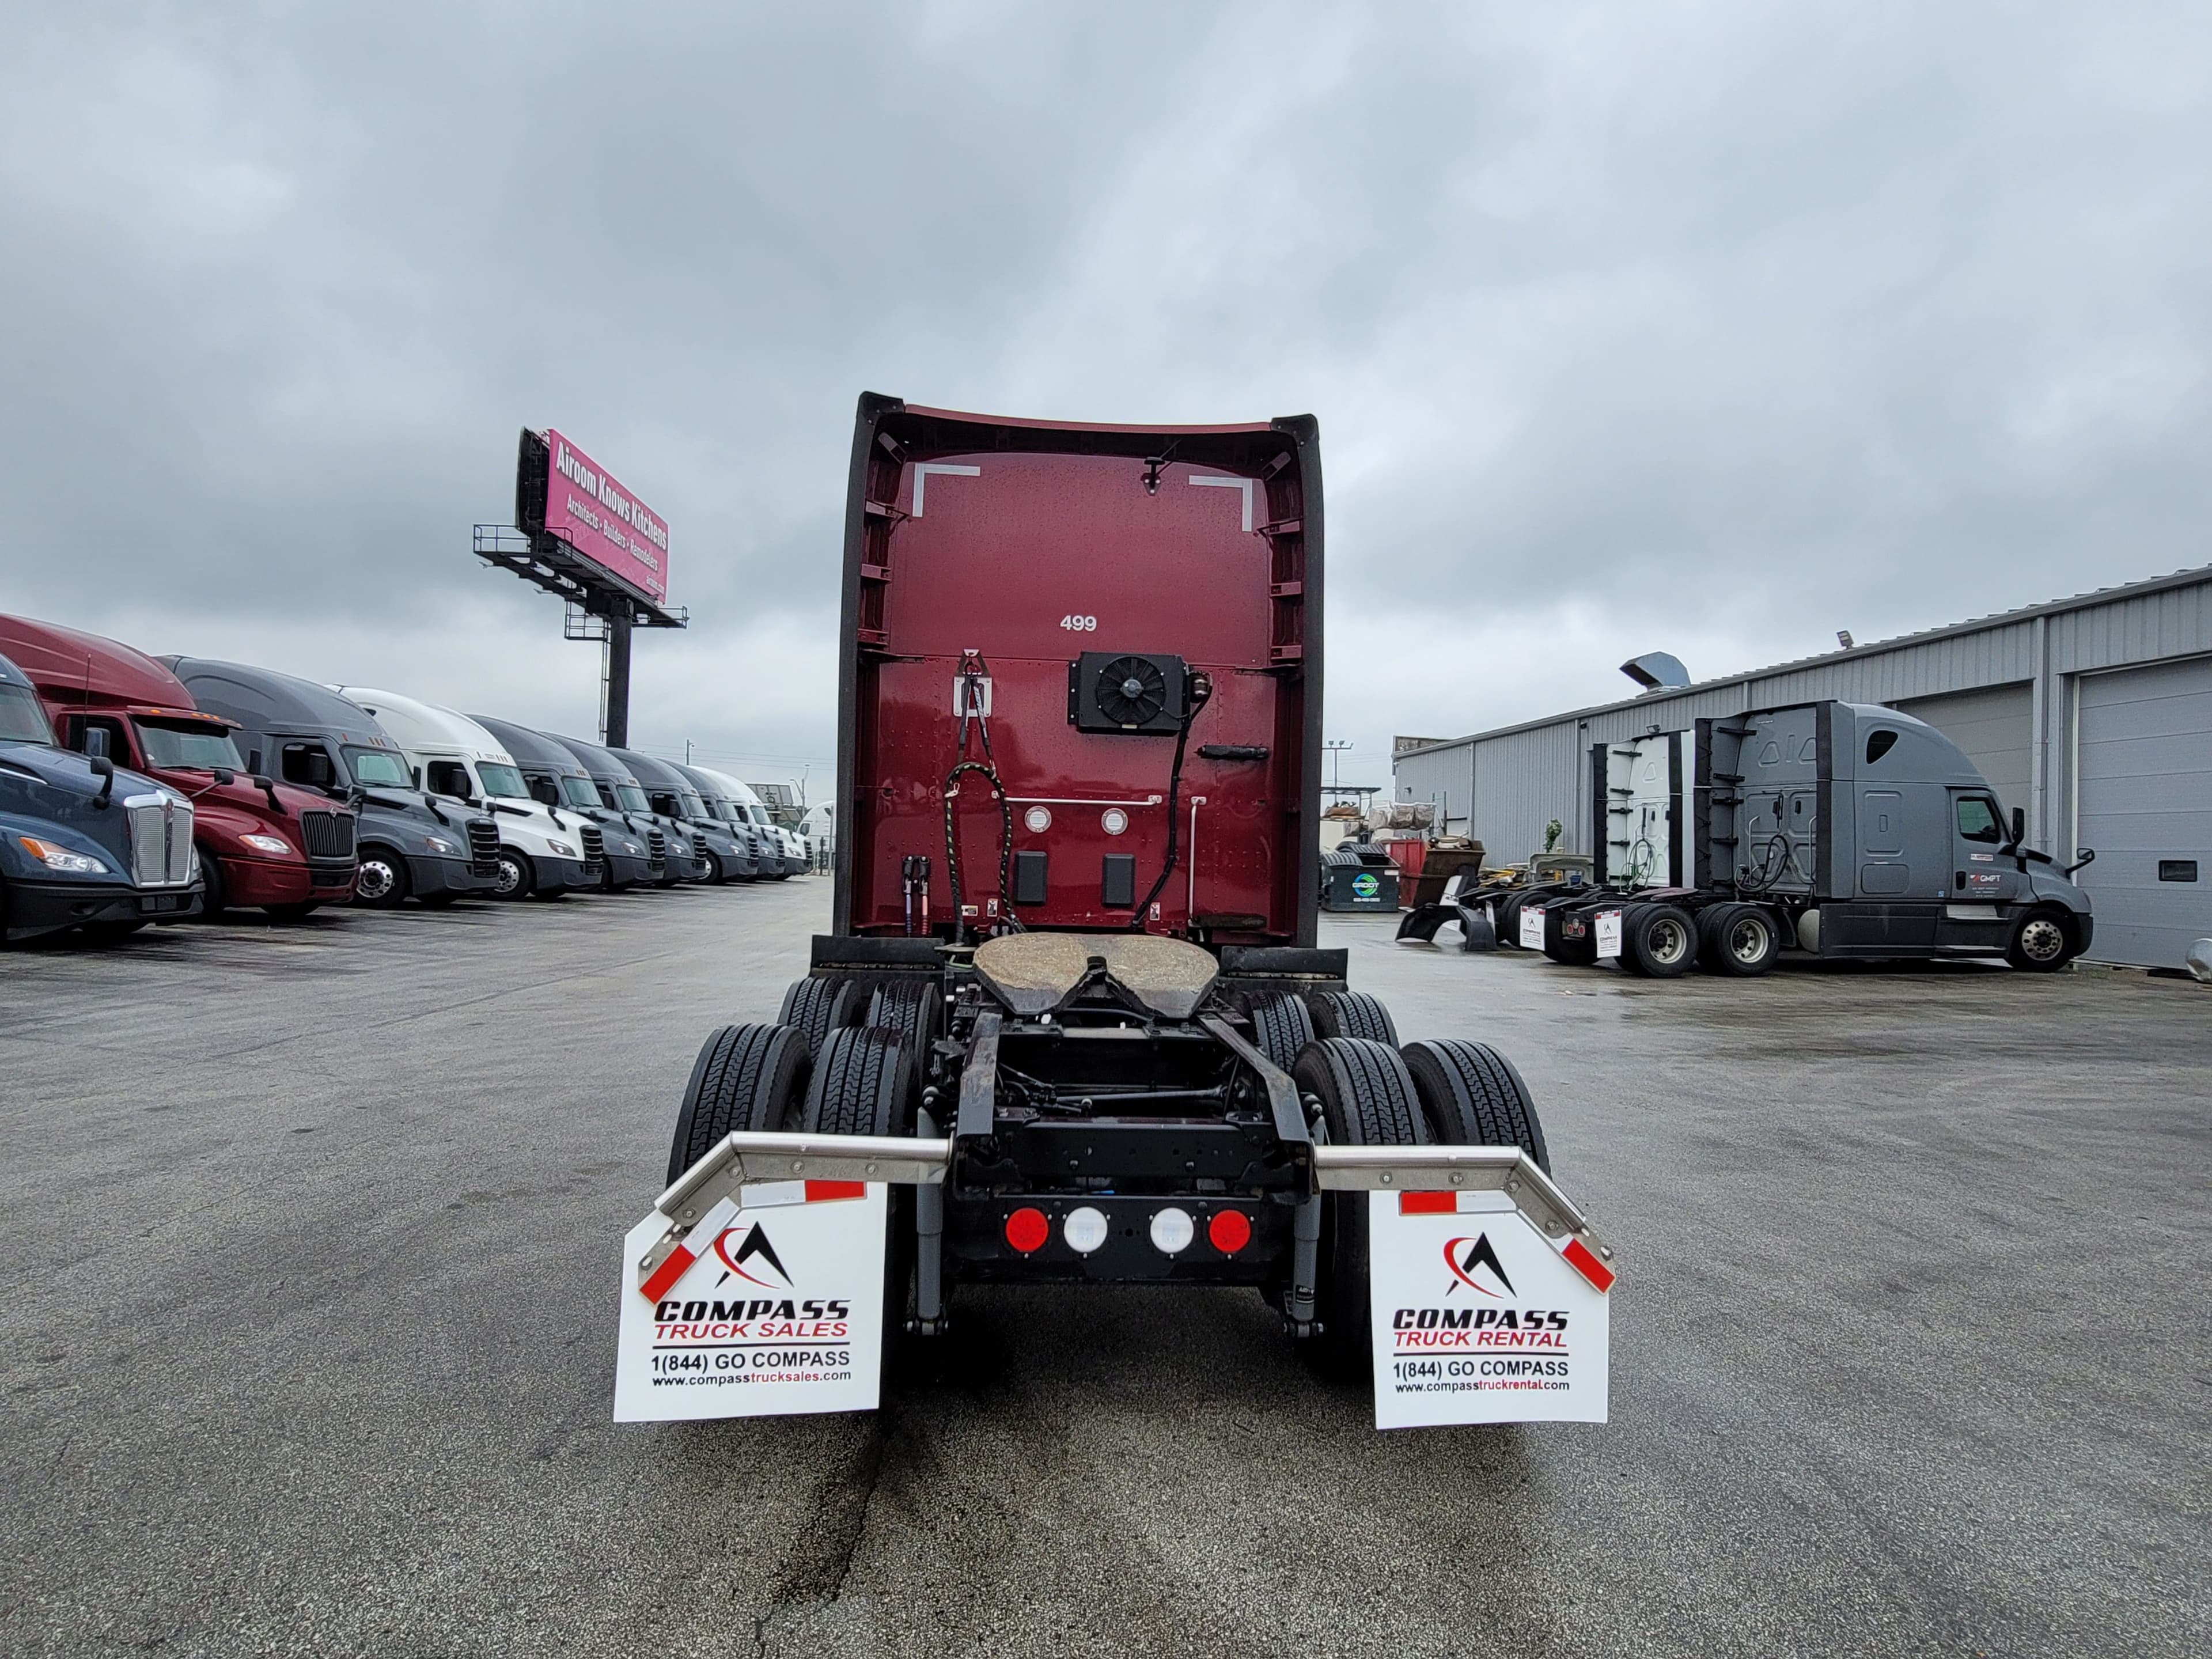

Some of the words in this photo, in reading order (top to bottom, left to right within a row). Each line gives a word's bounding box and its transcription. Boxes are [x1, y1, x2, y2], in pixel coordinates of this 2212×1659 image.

[556, 441, 597, 498] Airoom
[599, 474, 630, 522] Knows
[631, 500, 667, 551] Kitchens
[567, 493, 599, 530] Architects
[604, 521, 626, 549] Builders
[630, 539, 658, 572] Remodelers
[1060, 615, 1097, 631] 499
[654, 1300, 851, 1321] COMPASS
[1393, 1308, 1570, 1331] COMPASS
[655, 1323, 751, 1340] TRUCK
[757, 1322, 848, 1337] SALES
[1393, 1331, 1472, 1347] TRUCK
[1477, 1331, 1567, 1347] RENTAL
[651, 1354, 709, 1375] 1(844)
[715, 1353, 746, 1370] GO
[752, 1351, 850, 1368] COMPASS
[1393, 1361, 1442, 1381] 1(844)
[1448, 1361, 1475, 1377] GO
[1480, 1361, 1569, 1376] COMPASS
[653, 1371, 851, 1387] www.compasstrucksales.com
[1396, 1380, 1570, 1394] www.compasstruckrental.com
